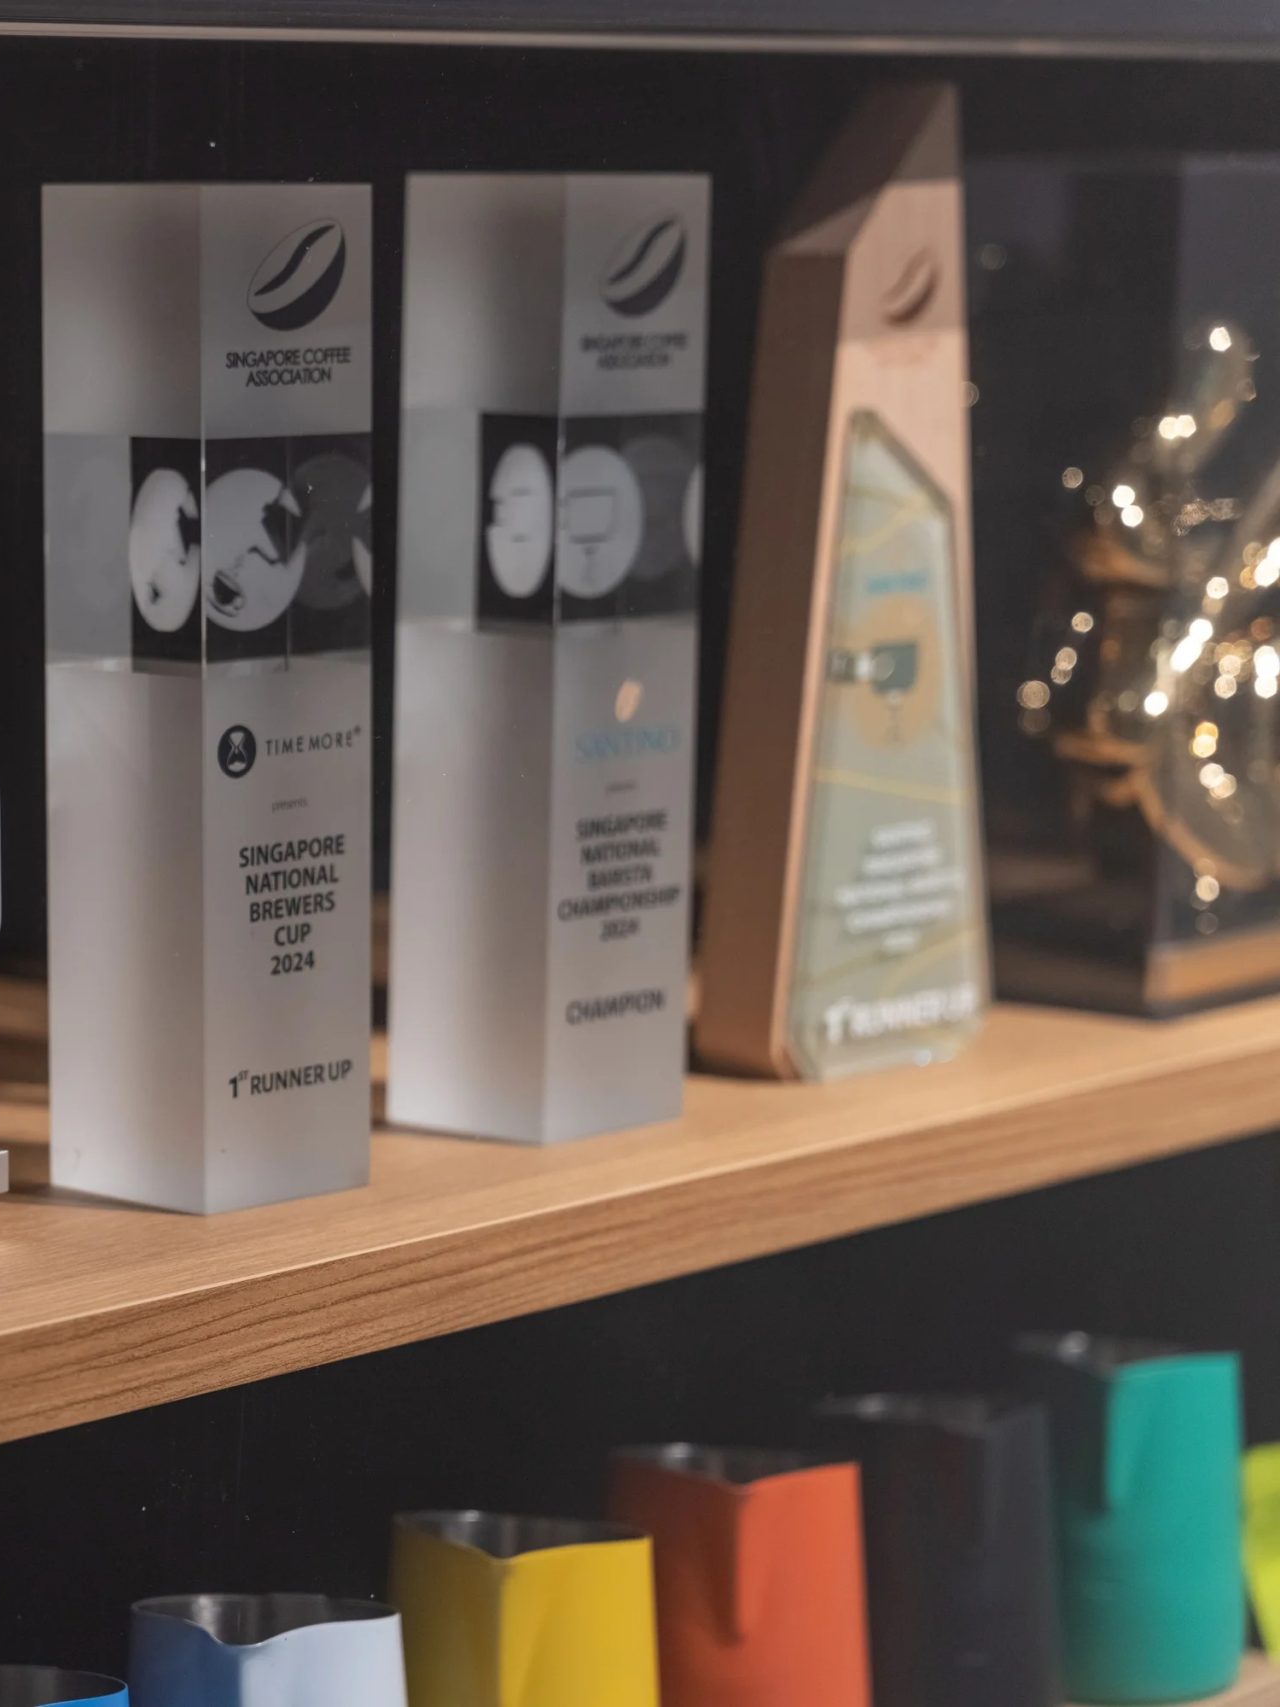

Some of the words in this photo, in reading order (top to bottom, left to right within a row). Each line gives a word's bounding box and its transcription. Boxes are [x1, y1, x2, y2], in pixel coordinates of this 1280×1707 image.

[226, 349, 301, 368] SINGAPORE
[302, 346, 351, 365] COFFEE
[246, 367, 332, 387] ASSOCIATION
[239, 834, 345, 868] SINGAPORE
[245, 864, 339, 896] NATIONAL
[250, 891, 335, 923] BREWERS
[274, 923, 310, 947] CUP
[270, 950, 315, 976] 2024
[565, 987, 666, 1026] CHAMPION
[250, 1064, 325, 1096] RUNNER
[328, 1058, 353, 1081] UP
